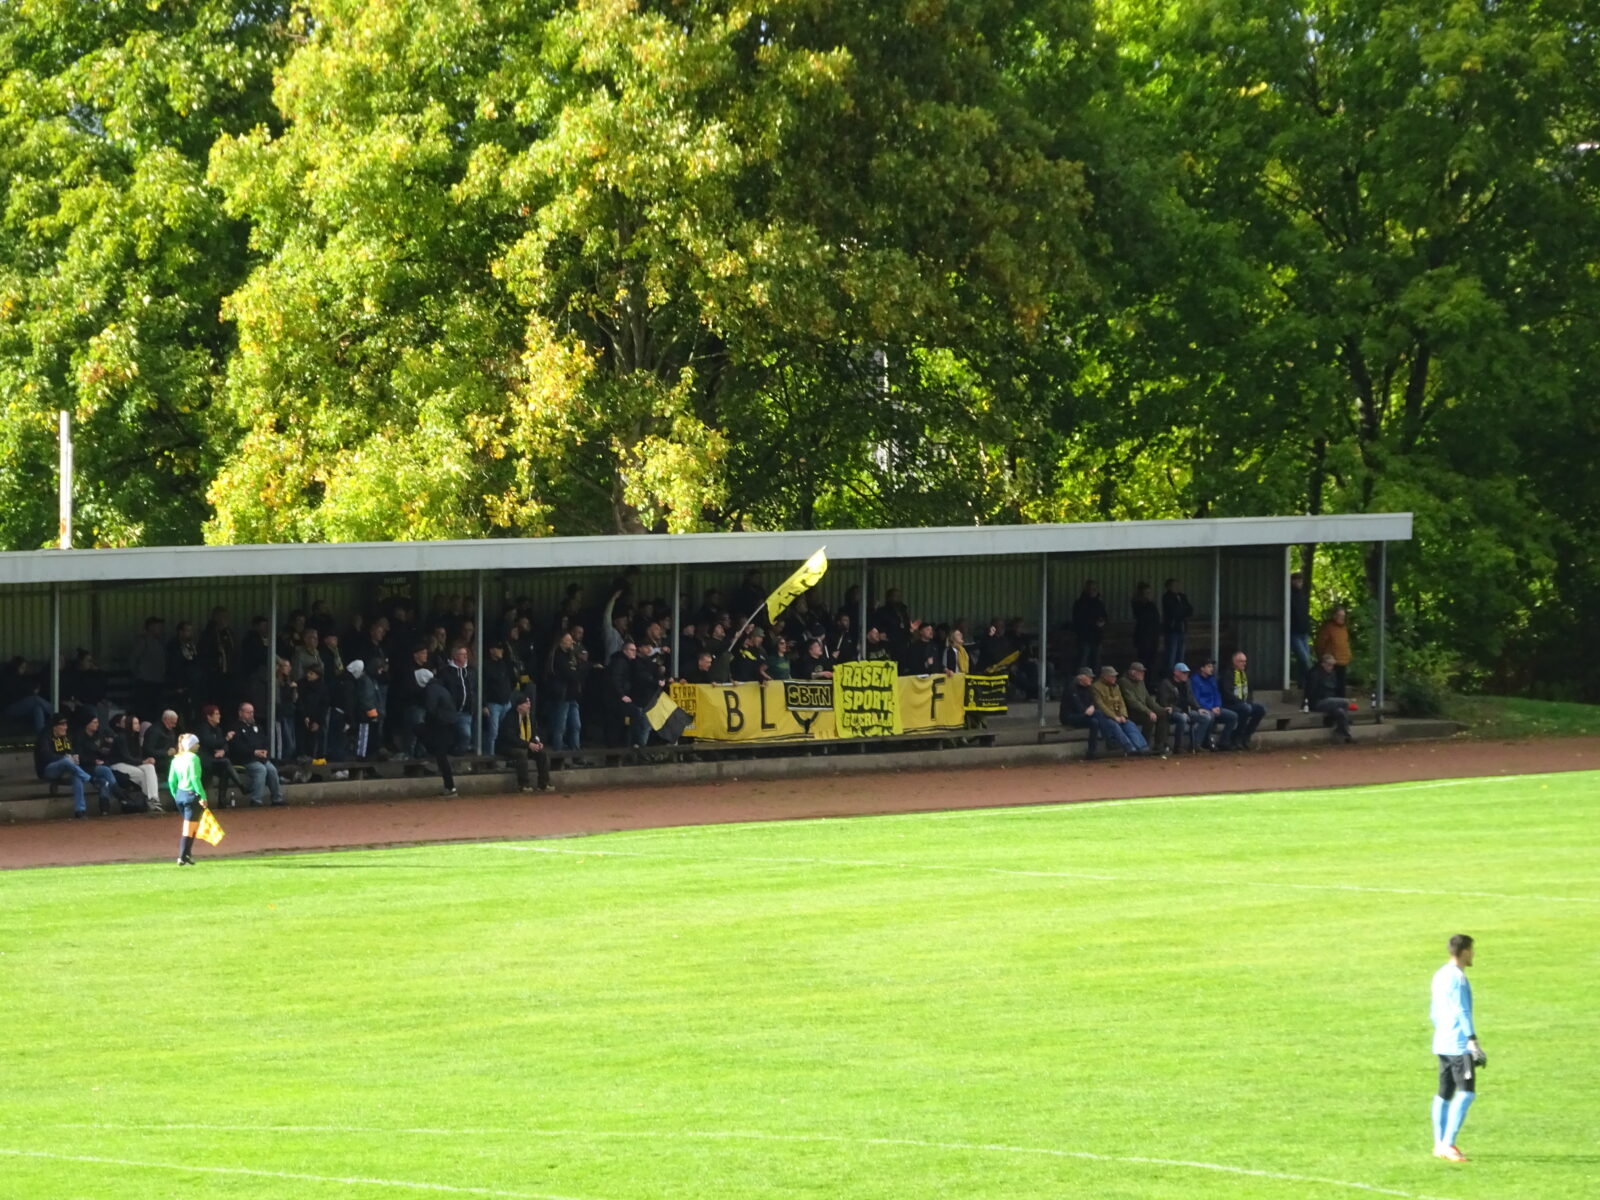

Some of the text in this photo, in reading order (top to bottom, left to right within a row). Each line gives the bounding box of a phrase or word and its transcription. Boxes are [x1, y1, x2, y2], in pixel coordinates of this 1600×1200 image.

[842, 665, 892, 687] RASEN
[787, 684, 832, 706] SBTN
[843, 690, 892, 710] SPORT
